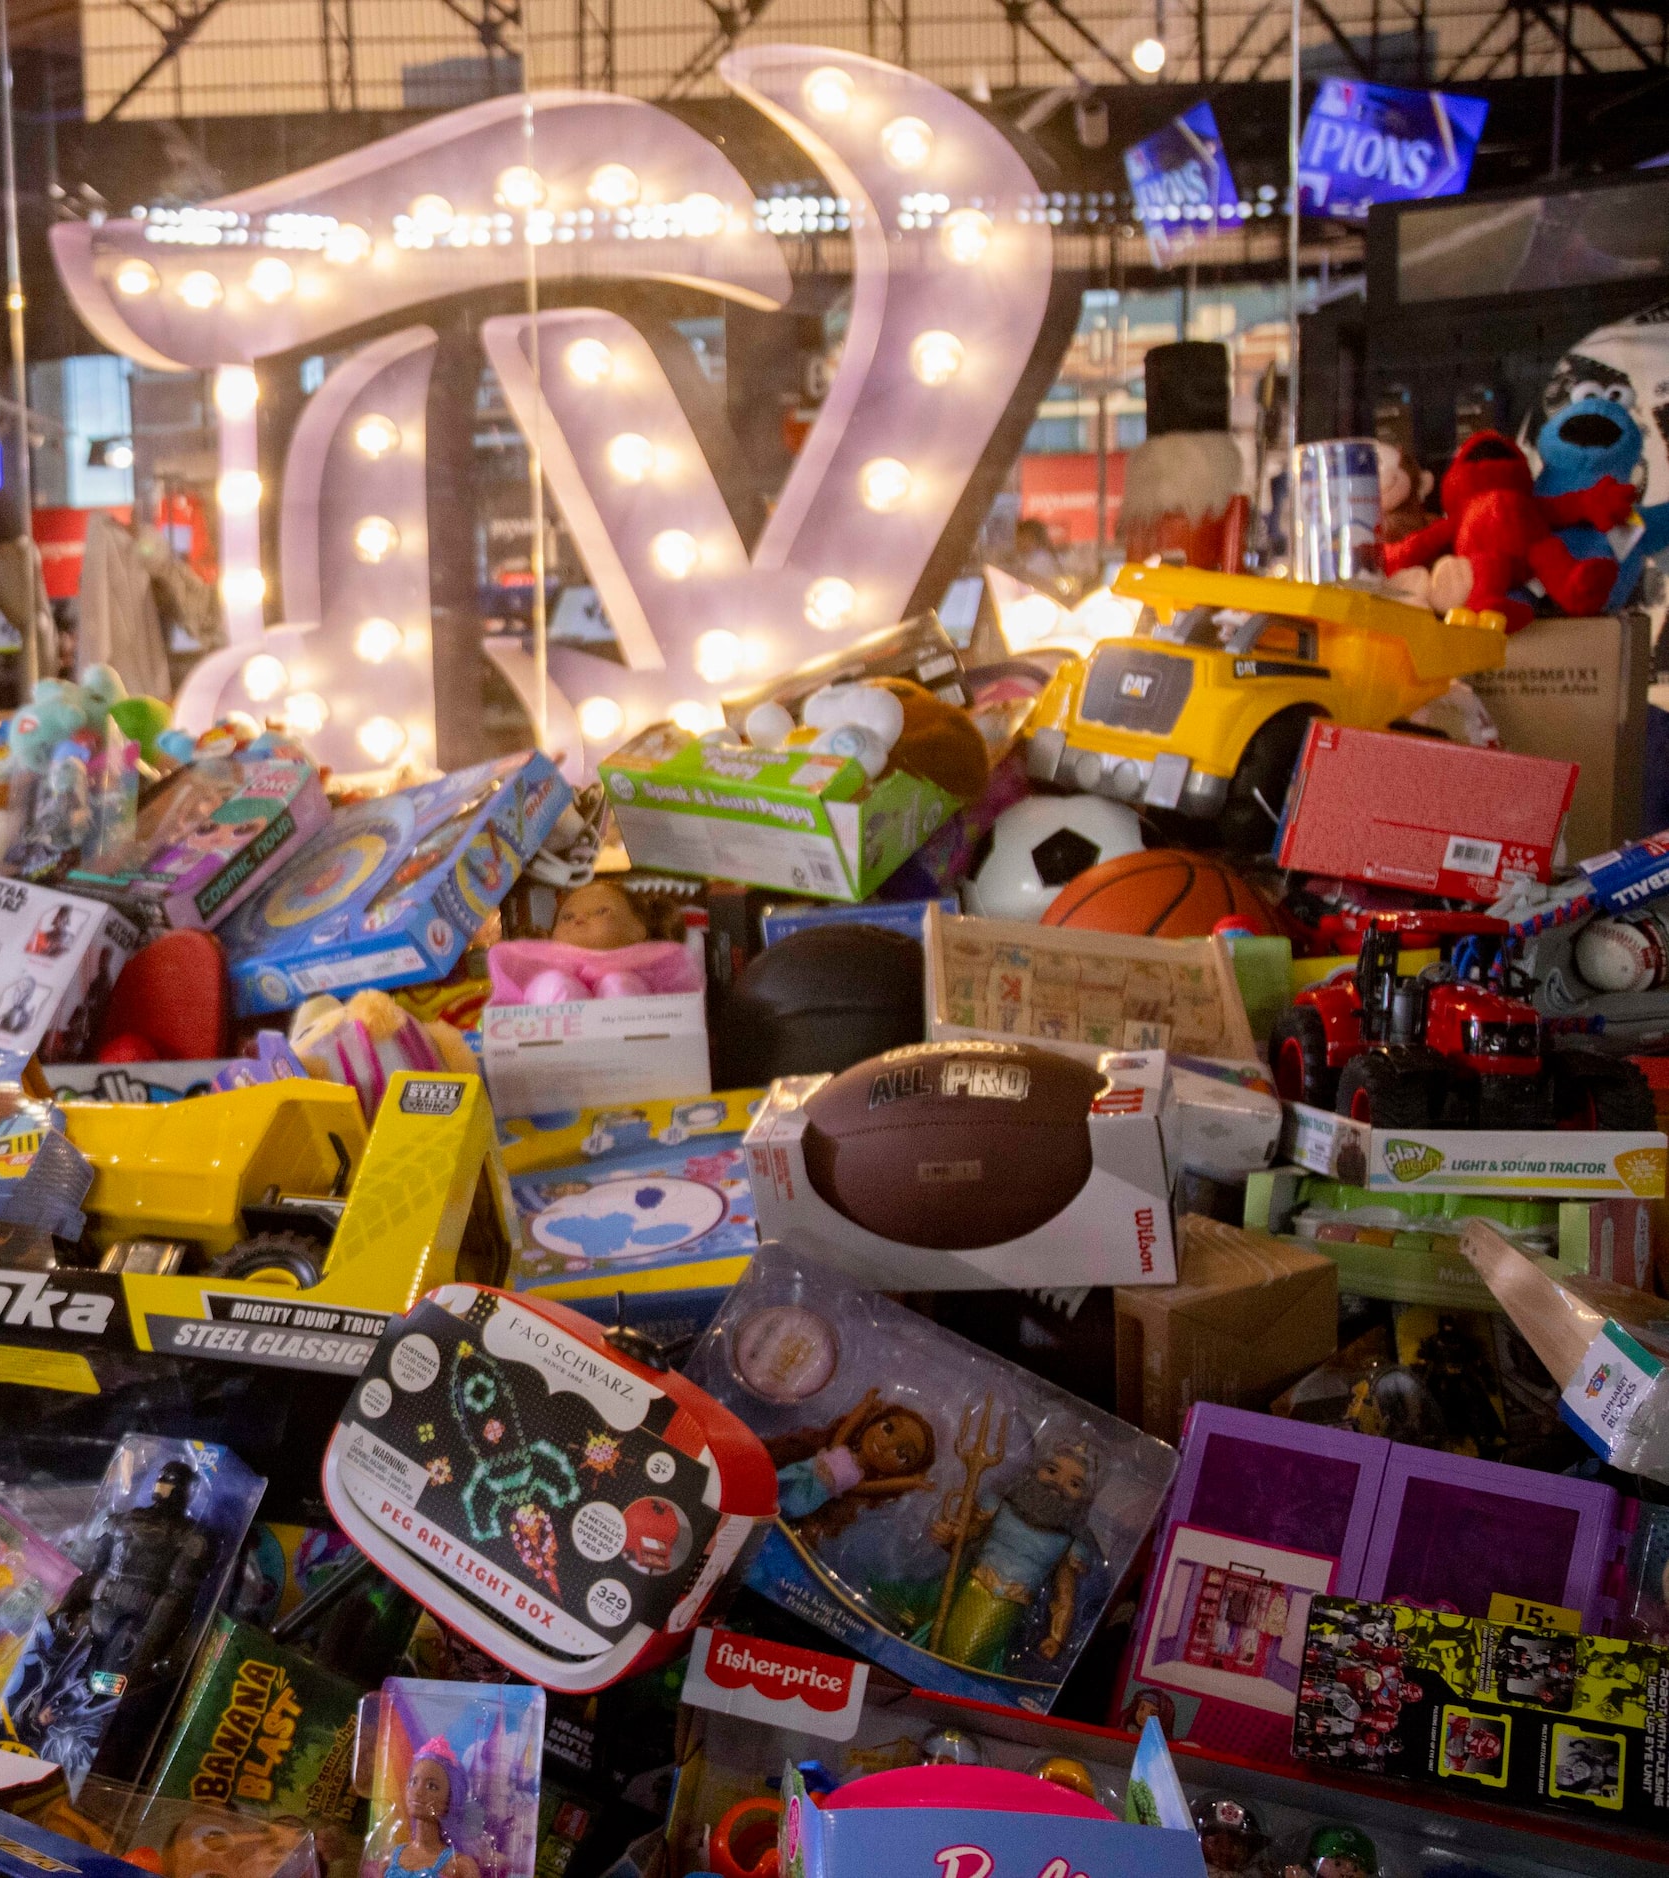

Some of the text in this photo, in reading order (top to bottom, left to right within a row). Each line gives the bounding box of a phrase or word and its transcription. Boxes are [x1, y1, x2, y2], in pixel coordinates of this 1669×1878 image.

[1234, 661, 1257, 677] CAT
[1120, 673, 1152, 699] CAT
[642, 780, 816, 829] Speak & Learn Puppy
[490, 1003, 587, 1019] PERFECTLY
[601, 1015, 616, 1025] My
[617, 1013, 646, 1024] Sweet
[408, 1088, 460, 1100] STEEL
[868, 1060, 1030, 1110] ALL PRO
[1383, 1142, 1428, 1170] play
[1450, 1159, 1607, 1175] LIGHT & SOUND TRACTOR
[1134, 1206, 1155, 1274] Wilson
[233, 1301, 386, 1337] MIGHTY DUMP TRUC
[172, 1323, 250, 1355] STEEL
[399, 1350, 433, 1375] YOUR OWN
[401, 1341, 437, 1369] CUSTOMIZE
[397, 1358, 428, 1381] GLOWING
[401, 1371, 416, 1382] ART
[1600, 1374, 1630, 1421] ALPHABET
[198, 1450, 218, 1466] DC
[372, 1443, 410, 1477] WARNING:
[650, 1463, 668, 1476] 3+
[578, 1518, 614, 1544] MARKERS
[588, 1513, 624, 1541] METALLIC
[590, 1506, 622, 1530] INCLUDES
[577, 1527, 614, 1554] OVER 300
[581, 1539, 601, 1556] PEGS
[381, 1500, 556, 1630] PEG ART LIGHT BOX
[590, 1595, 623, 1622] PIECES
[595, 1585, 627, 1611] 329
[1513, 1602, 1556, 1628] 15+
[715, 1642, 844, 1694] fisher-price
[191, 1659, 278, 1802] BANANA
[236, 1687, 303, 1800] BLAST
[1642, 1675, 1658, 1794] LIGHT-UP EYE UNIT
[1654, 1667, 1669, 1808] ROBOT WITH PULSING
[306, 1783, 324, 1812] The
[319, 1742, 340, 1783] game
